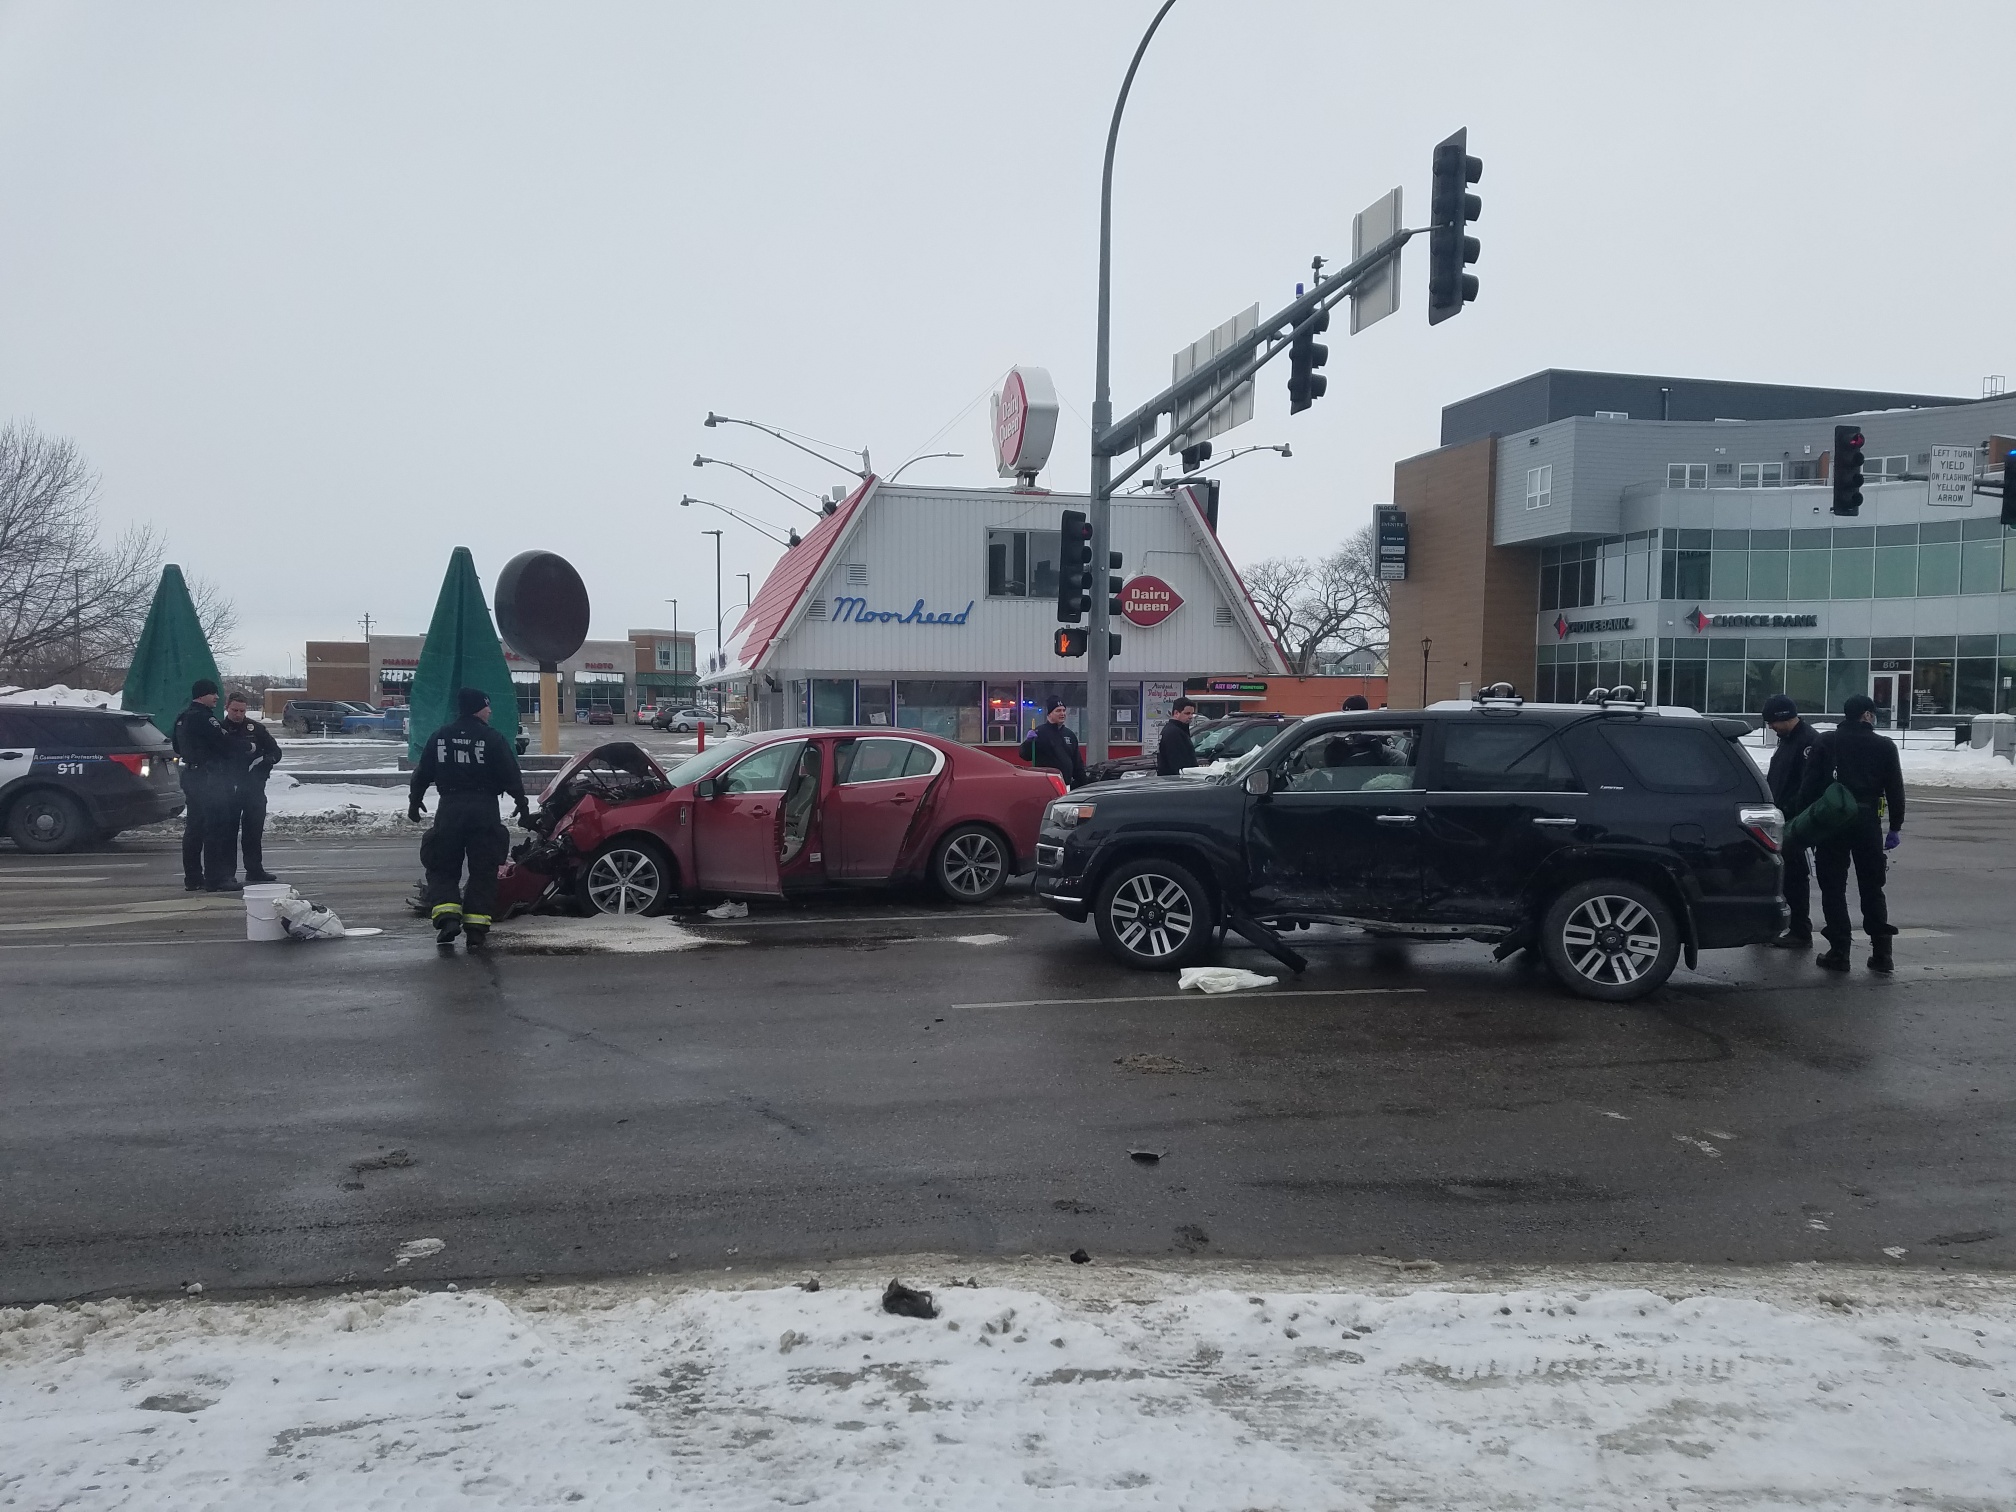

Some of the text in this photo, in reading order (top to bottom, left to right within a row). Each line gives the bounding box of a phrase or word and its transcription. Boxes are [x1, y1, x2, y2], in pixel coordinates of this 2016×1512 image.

[1002, 394, 1020, 422] Dairy
[1000, 416, 1020, 448] Queen
[1933, 449, 1973, 458] LEFT TURN
[1940, 460, 1965, 470] YIELD
[1931, 472, 1972, 482] ON FLASHING
[1937, 483, 1966, 492] YELLOW
[1937, 494, 1964, 502] ARROW
[1131, 587, 1170, 602] Dairy
[832, 597, 975, 625] Moorhead
[1124, 601, 1169, 613] Queen
[1601, 617, 1630, 631] BANK
[1712, 614, 1818, 628] CHOICE BANK
[585, 662, 614, 670] PHOTO
[1882, 661, 1900, 669] 801
[1147, 689, 1178, 699] Dairy Queen
[57, 763, 84, 775] 911
